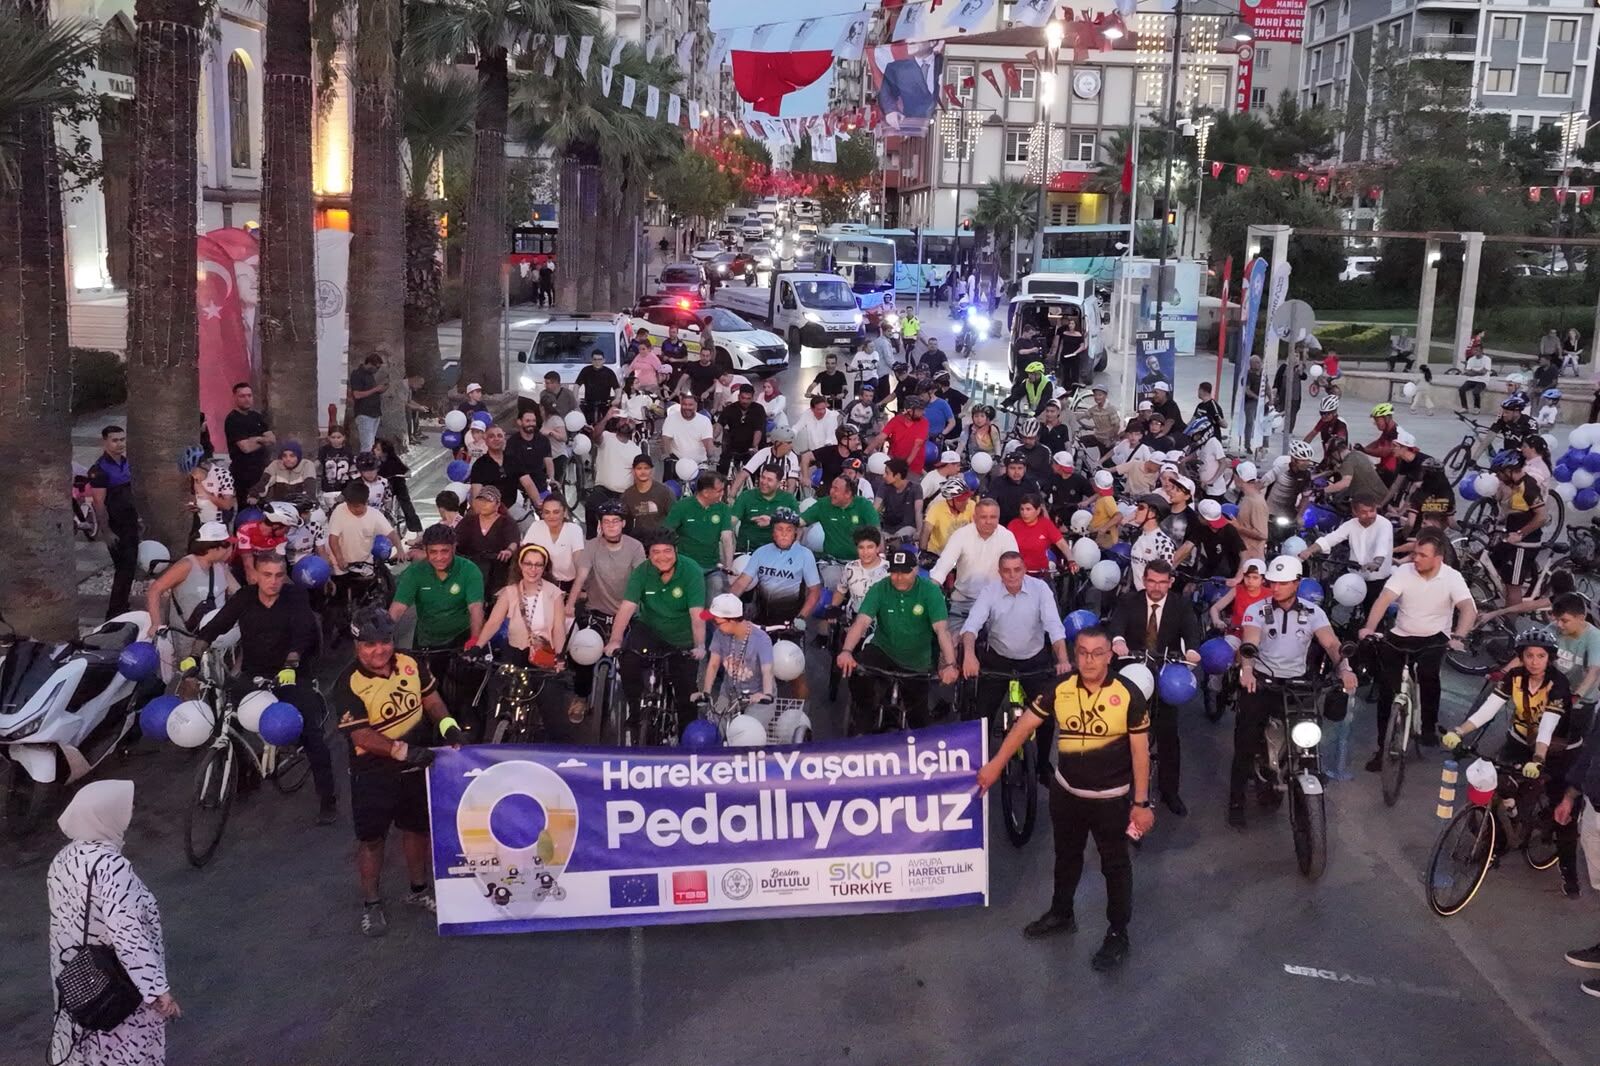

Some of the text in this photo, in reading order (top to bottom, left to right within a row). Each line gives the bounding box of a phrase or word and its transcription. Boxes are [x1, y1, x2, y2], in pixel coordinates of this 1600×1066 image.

[1276, 0, 1303, 9] MANİSA
[1254, 17, 1282, 27] BAHRİ
[1253, 28, 1286, 39] ENÇLİK
[758, 566, 794, 579] STRAVA
[603, 736, 971, 790] Hareketli Yaşam İçin
[606, 789, 973, 849] Pedallıyoruz
[908, 858, 943, 867] AVRUPA
[770, 868, 800, 879] Besim
[829, 861, 891, 881] SKUP
[908, 863, 974, 877] HAREKETLİLİK
[761, 877, 810, 889] DUTLULU
[908, 876, 944, 887] HAFTASI
[830, 879, 893, 897] TÜRKİYE
